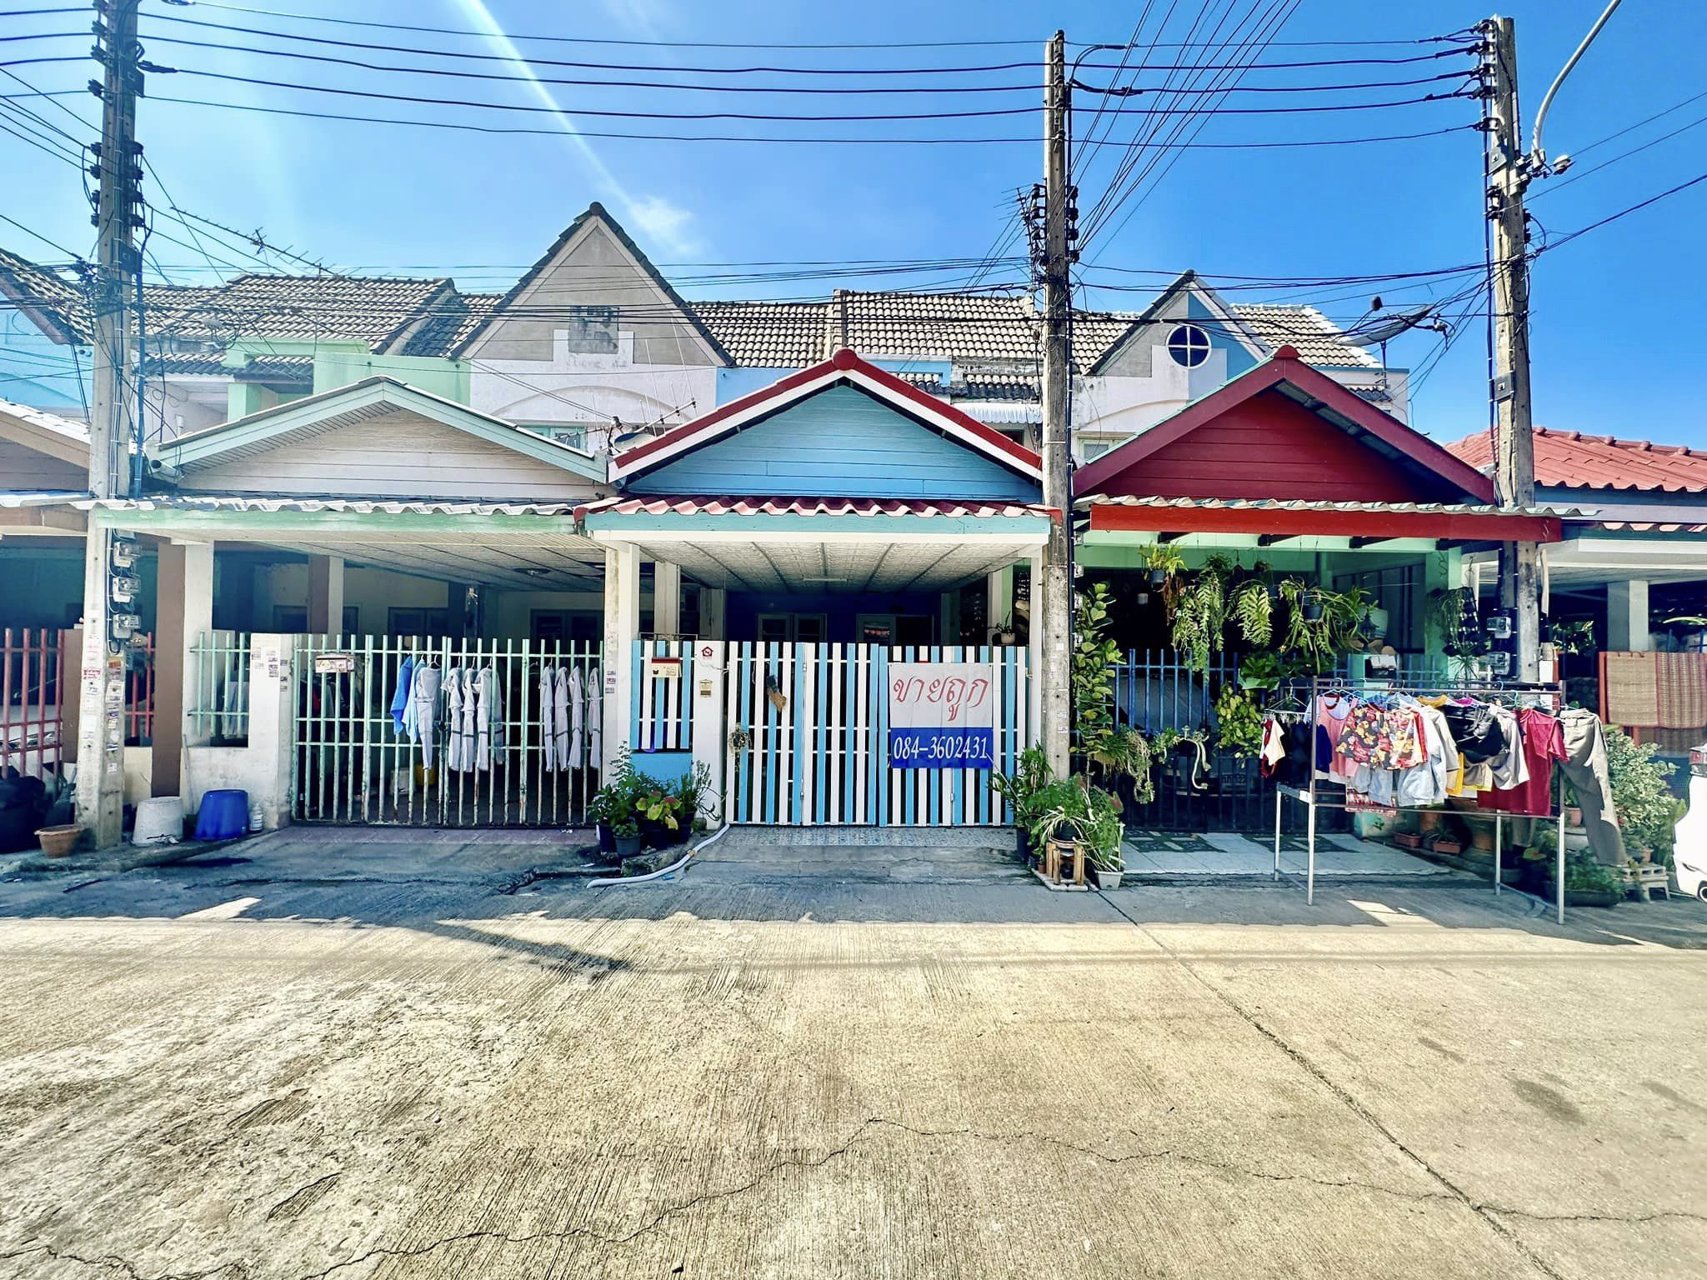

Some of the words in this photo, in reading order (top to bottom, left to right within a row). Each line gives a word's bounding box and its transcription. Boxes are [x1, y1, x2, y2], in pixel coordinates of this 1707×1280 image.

[893, 676, 988, 721] ขายถูก
[893, 736, 987, 759] 084-3602431
